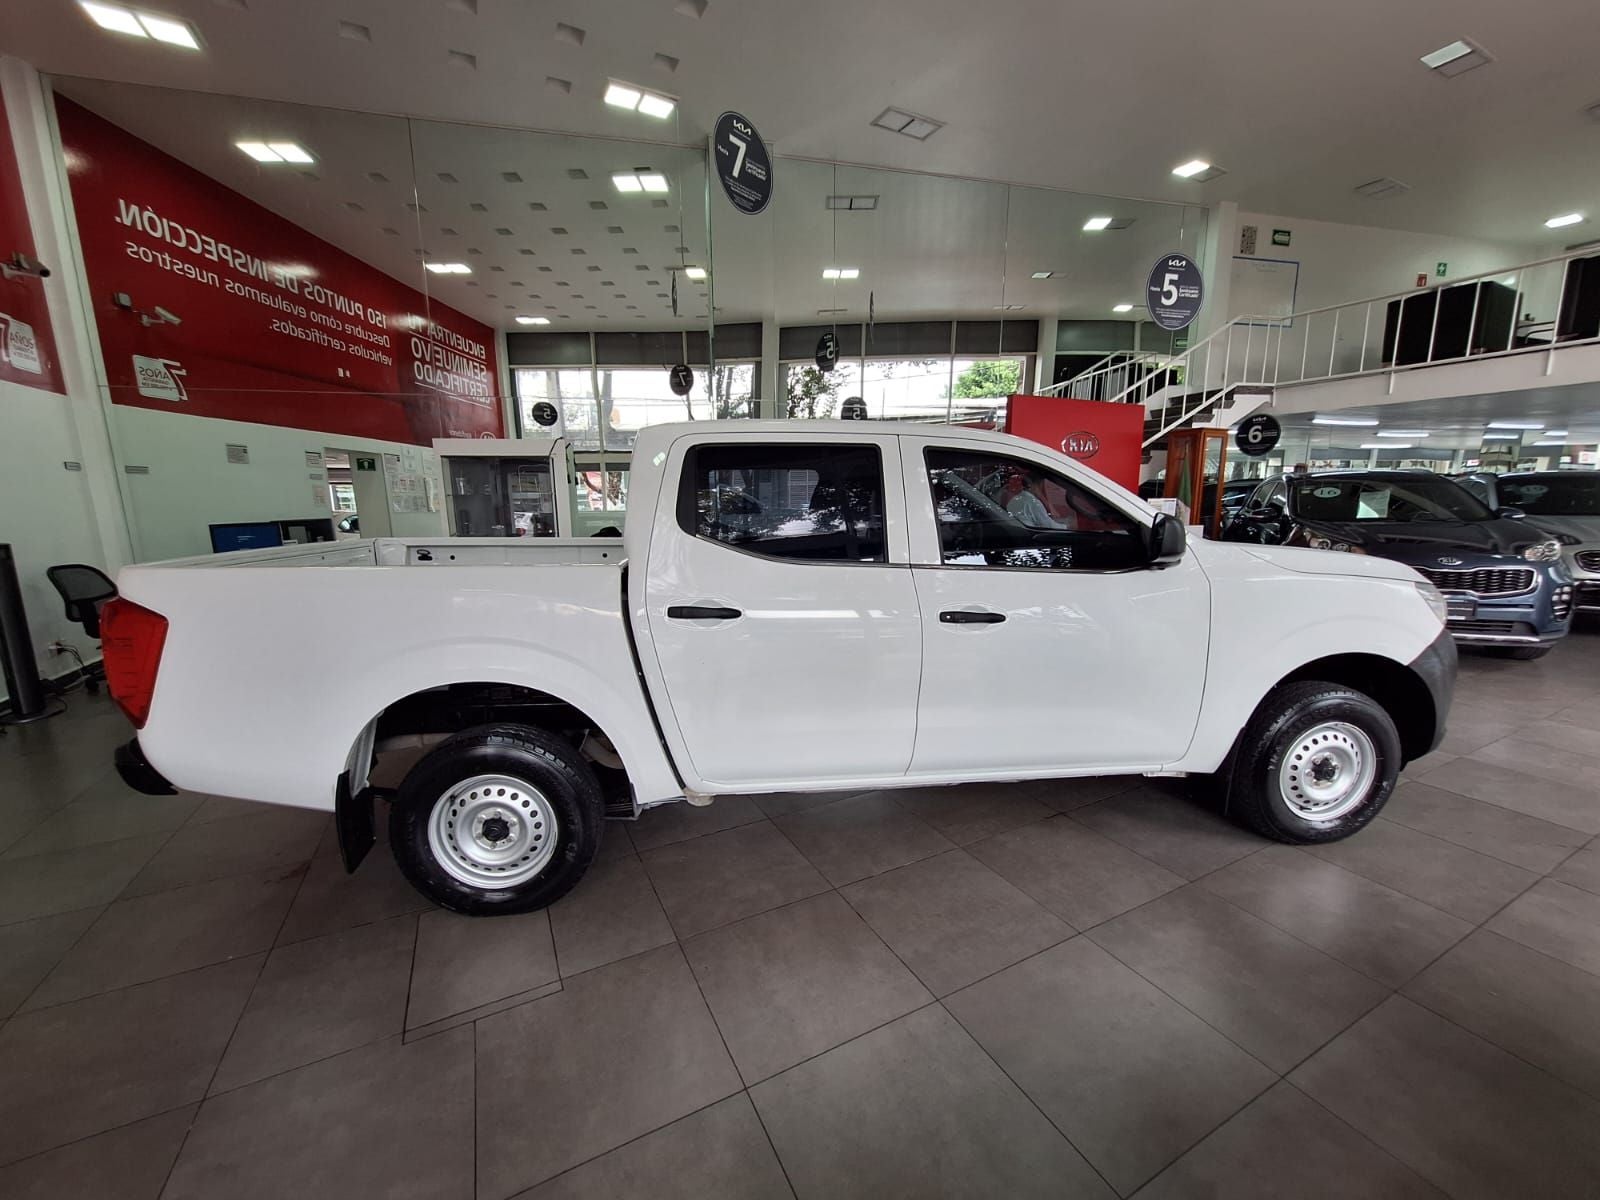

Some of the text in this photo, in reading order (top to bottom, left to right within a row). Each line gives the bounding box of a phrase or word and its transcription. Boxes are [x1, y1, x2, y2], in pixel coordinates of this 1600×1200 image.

[733, 119, 752, 136] KIA
[729, 133, 747, 179] 7
[1168, 259, 1187, 267] KIA
[1161, 273, 1179, 306] 5
[1247, 425, 1262, 444] 6
[1069, 438, 1094, 452] KIA
